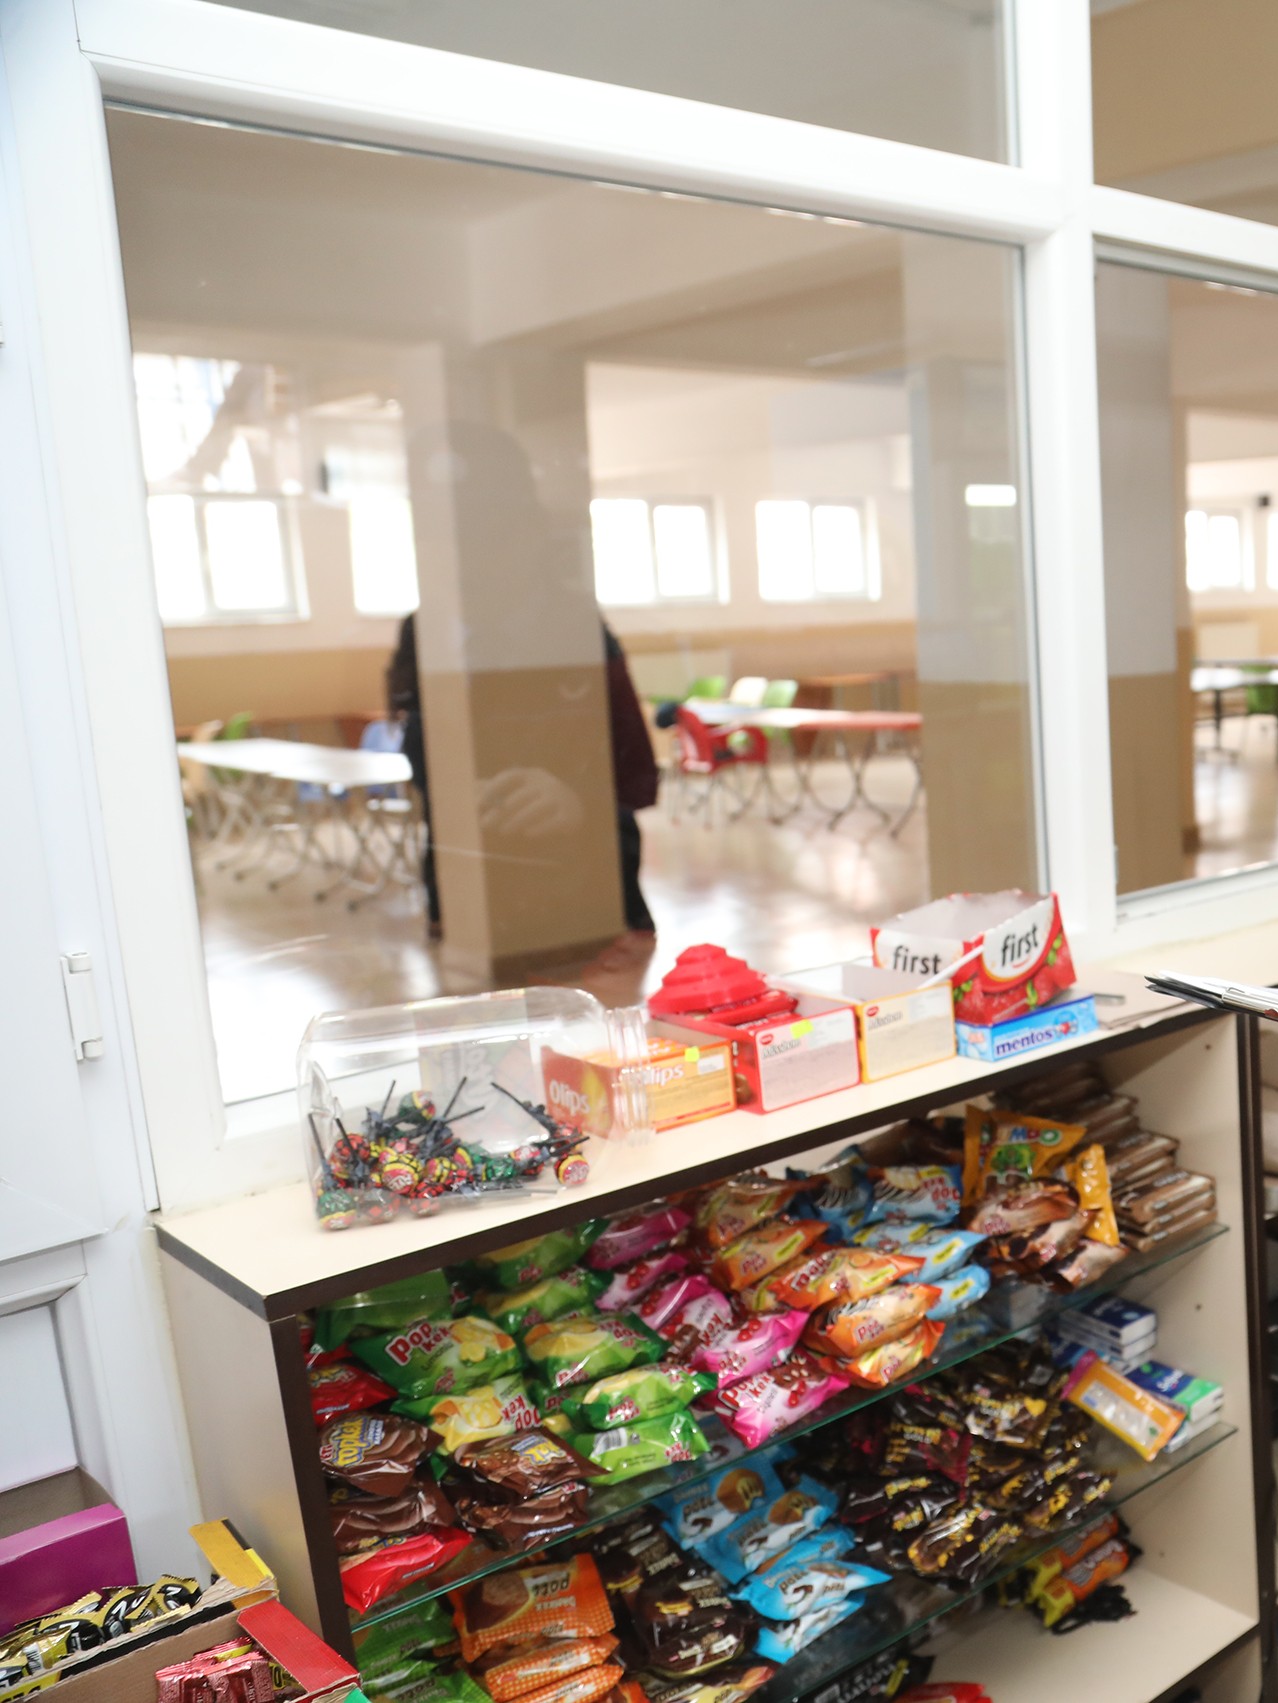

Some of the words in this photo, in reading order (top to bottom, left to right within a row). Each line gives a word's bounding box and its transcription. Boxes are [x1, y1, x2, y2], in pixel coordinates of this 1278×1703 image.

[893, 945, 942, 974] first
[1001, 924, 1039, 967] first
[996, 1023, 1054, 1056] mentos
[549, 1080, 591, 1114] Olips
